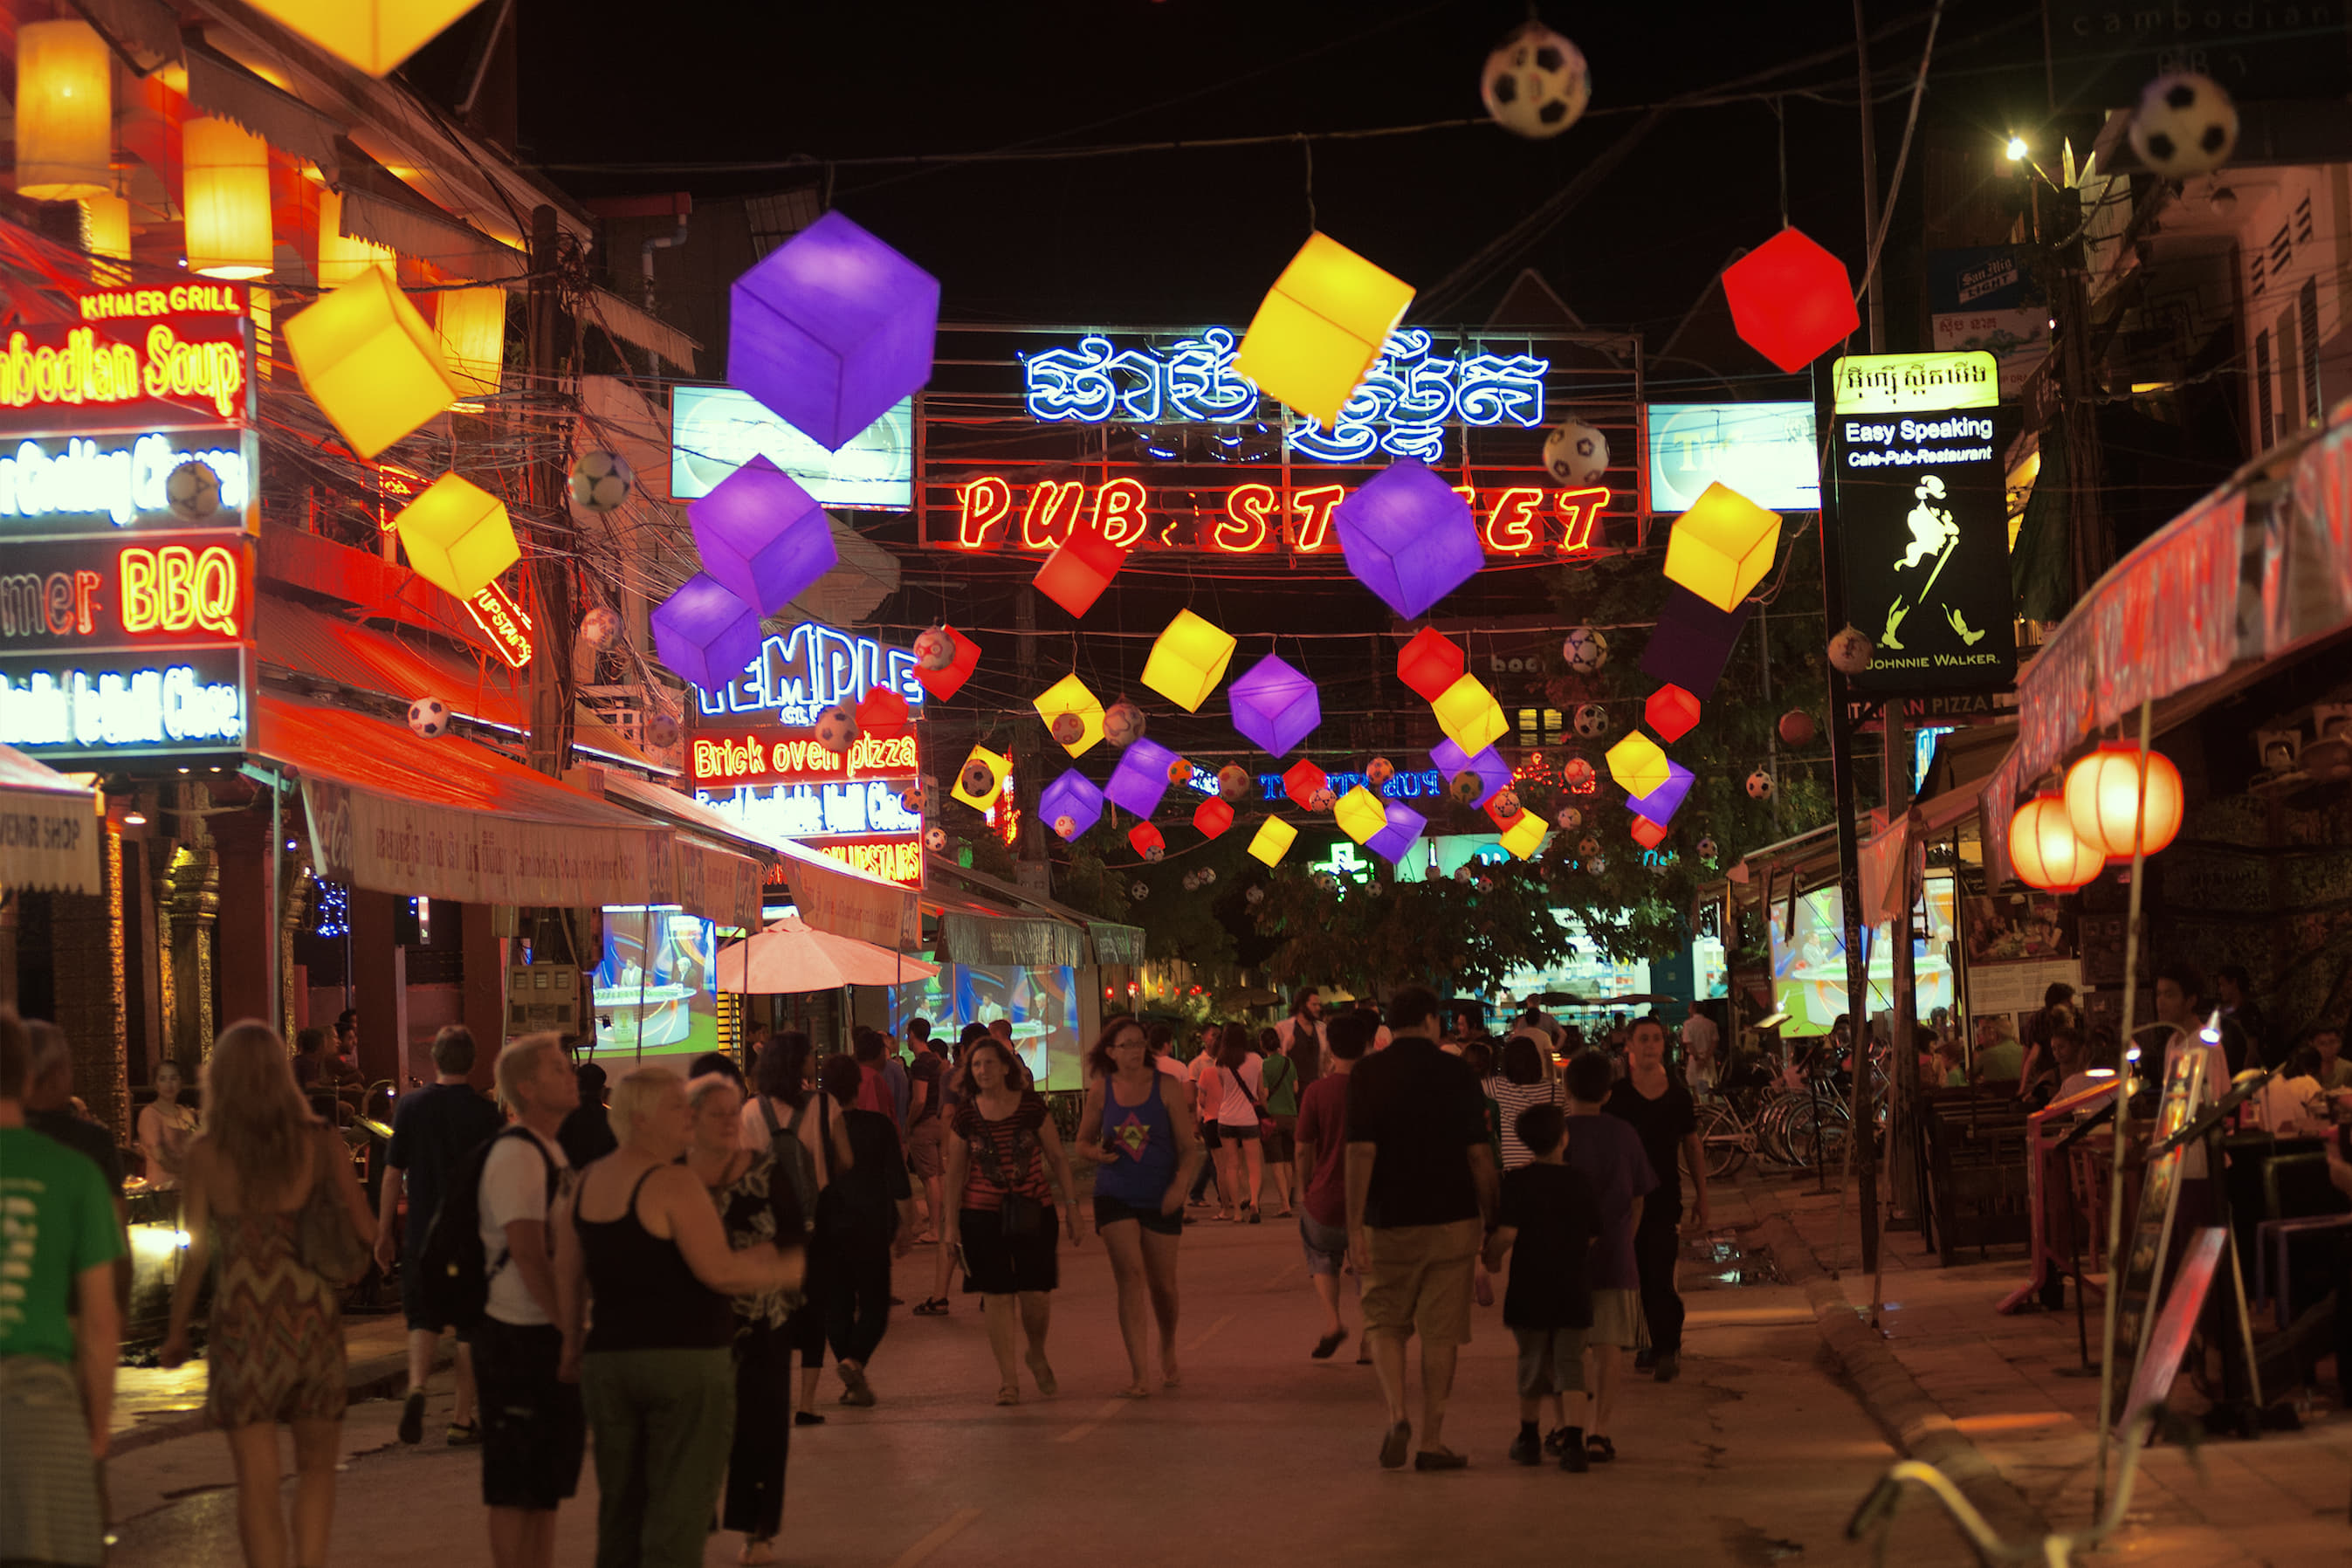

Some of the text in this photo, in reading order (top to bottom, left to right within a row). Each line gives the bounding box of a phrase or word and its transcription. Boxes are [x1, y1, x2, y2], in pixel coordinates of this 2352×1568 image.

[80, 285, 240, 319] KHMER GRILL
[142, 323, 241, 416] Soup
[1845, 416, 1993, 445] Easy Speaking
[958, 477, 1611, 553] PUB STET
[120, 546, 237, 636] BBQ
[1866, 657, 1930, 671] JOHNNIE
[1932, 695, 1989, 714] PIZZA
[694, 735, 766, 778] Brick
[847, 731, 917, 777] pizza
